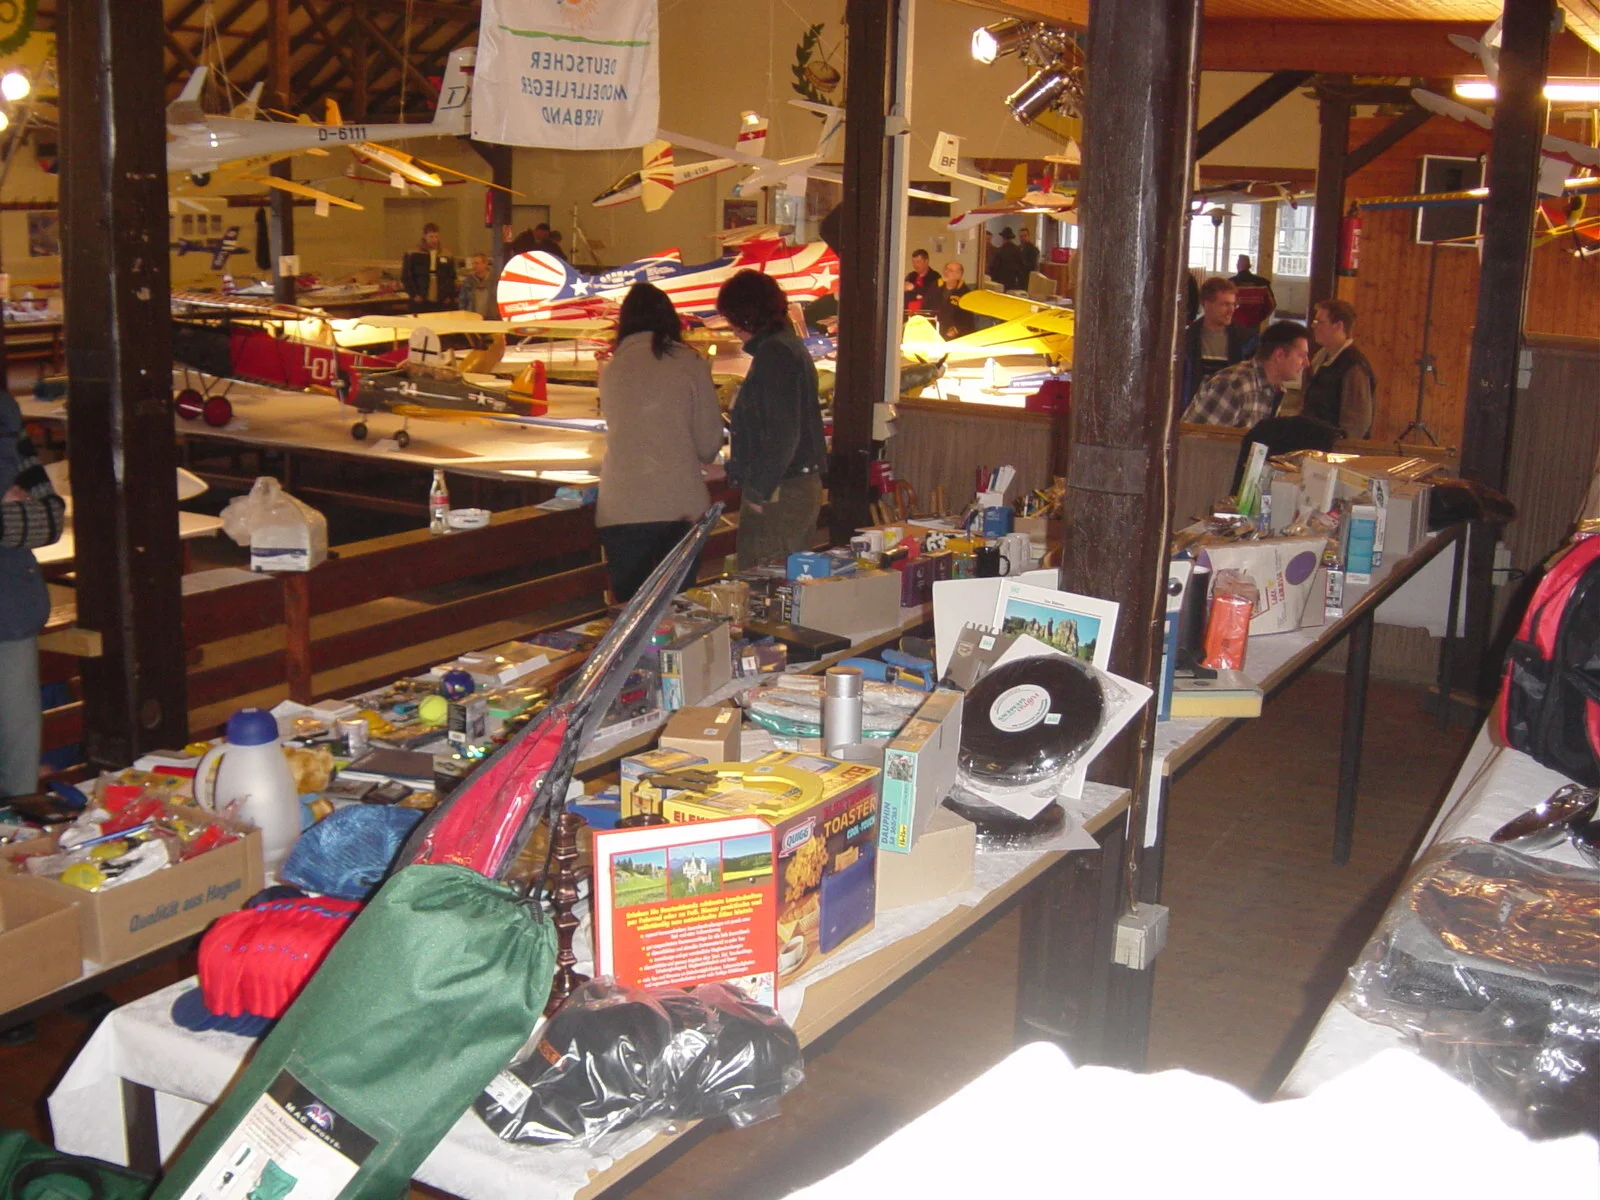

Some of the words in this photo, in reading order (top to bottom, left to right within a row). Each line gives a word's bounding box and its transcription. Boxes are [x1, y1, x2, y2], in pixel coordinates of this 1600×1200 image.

[318, 127, 367, 141] D-6111
[941, 156, 957, 167] BF
[399, 381, 417, 396] 34
[823, 796, 877, 838] TOASTER
[881, 801, 891, 844] DAUPHIN
[786, 827, 810, 847] QUIGG
